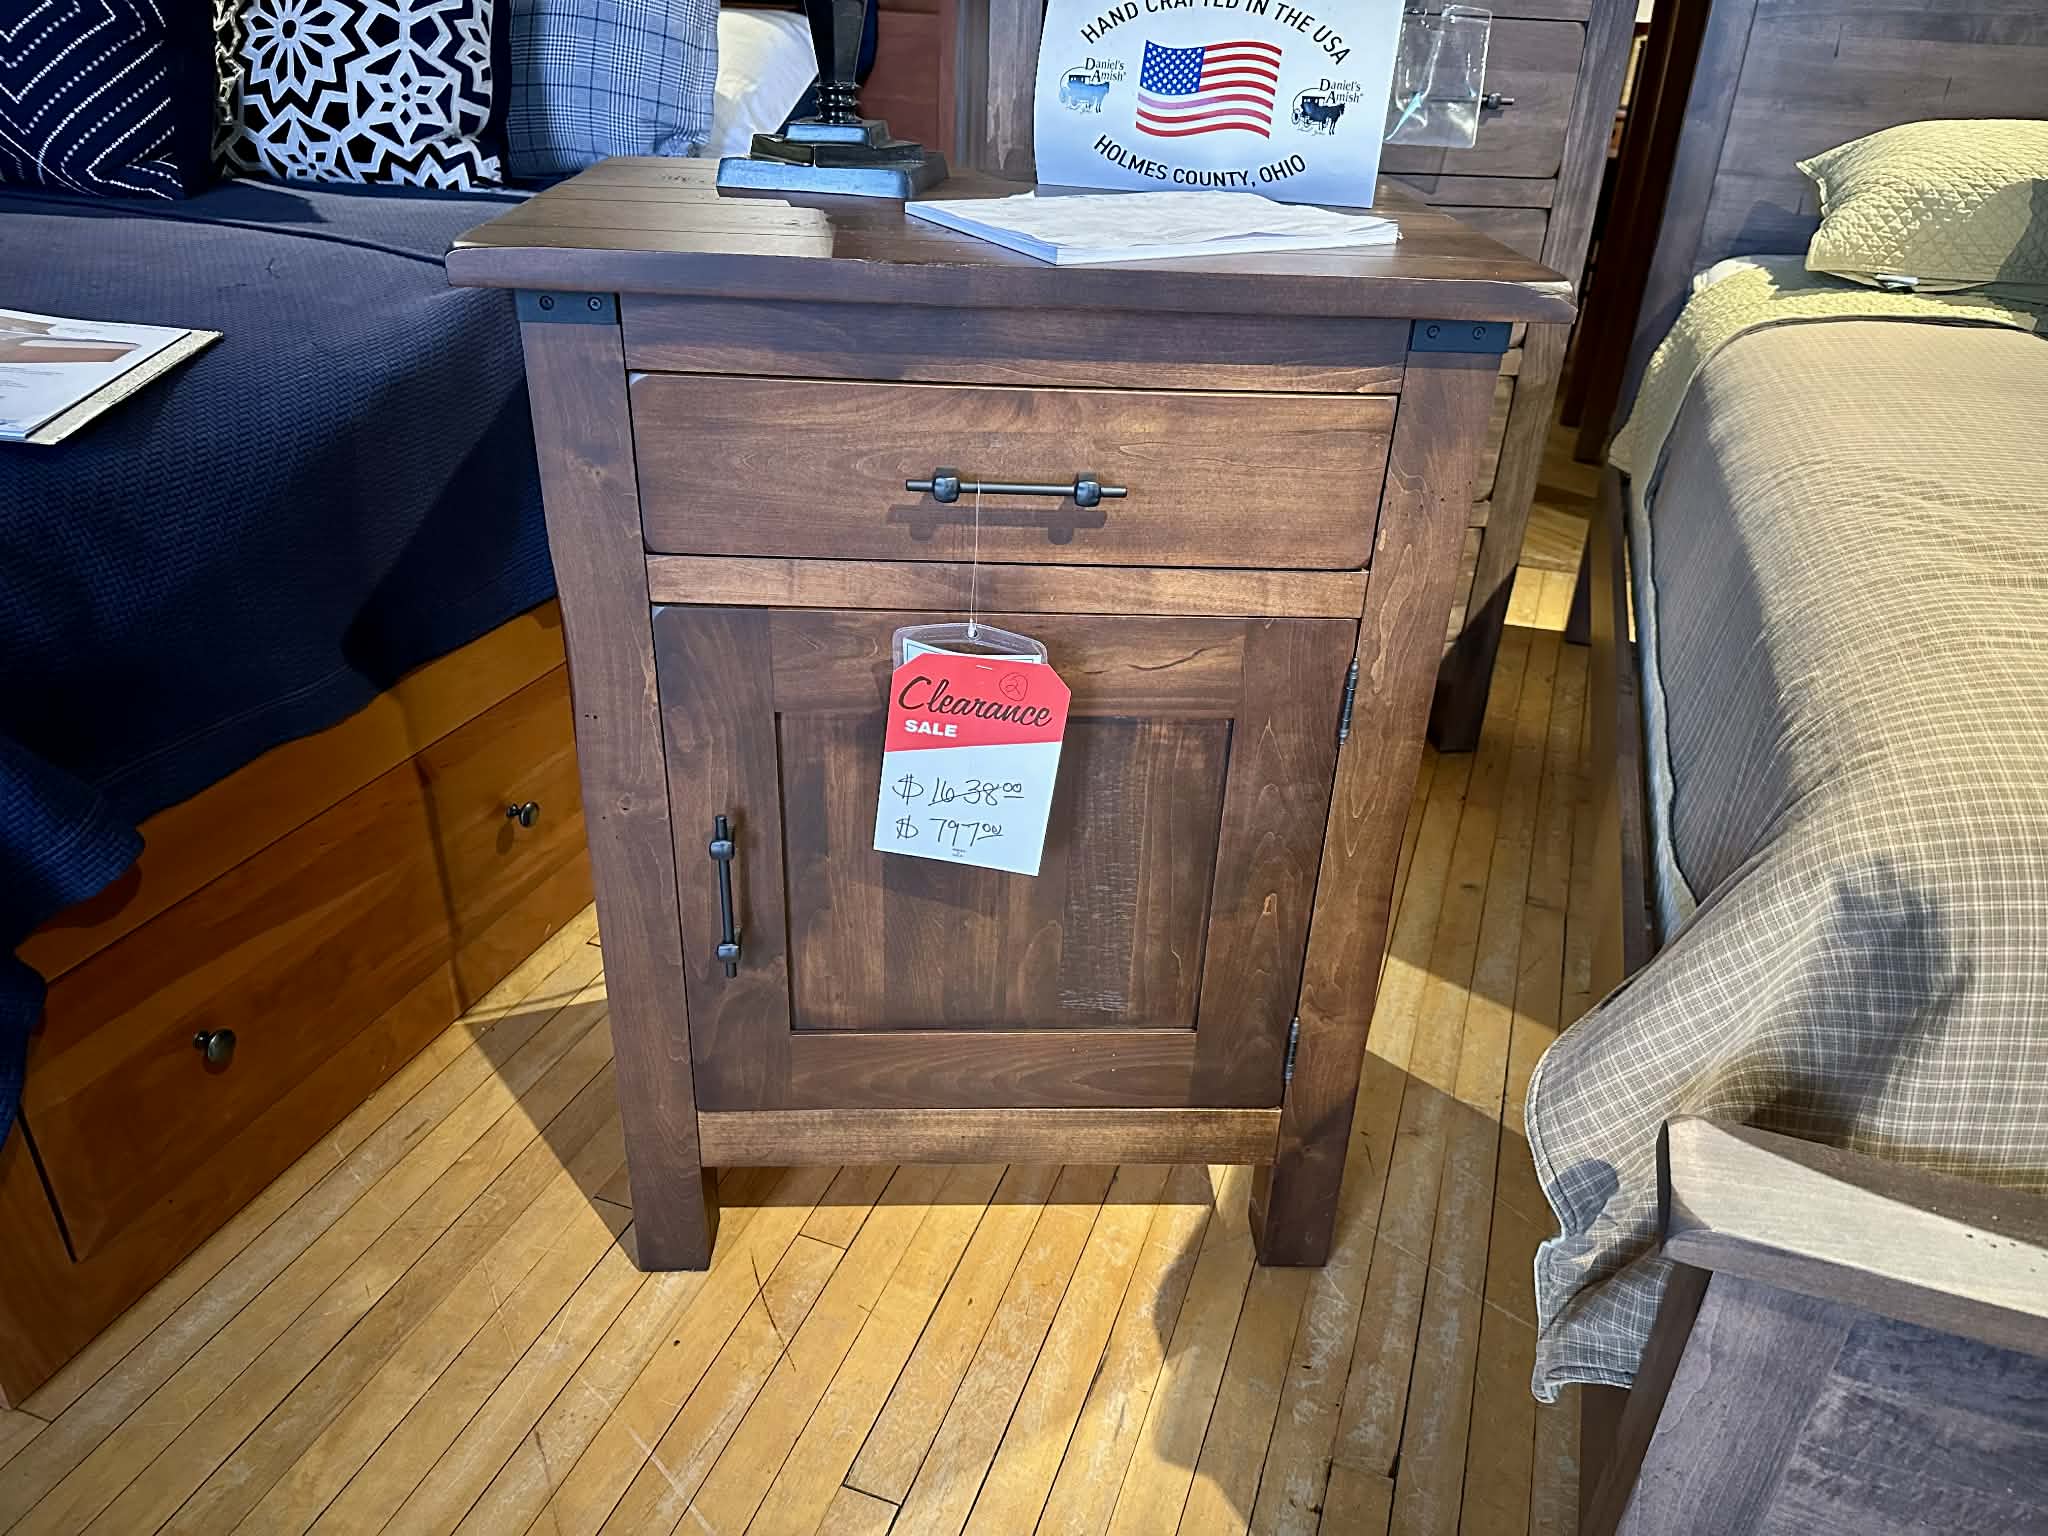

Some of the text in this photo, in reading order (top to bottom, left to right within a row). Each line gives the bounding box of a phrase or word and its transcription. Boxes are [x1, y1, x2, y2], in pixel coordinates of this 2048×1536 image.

[1080, 2, 1139, 44] HAND
[1245, 0, 1270, 15] IN
[1274, 2, 1316, 33] THE
[1312, 24, 1351, 65] USA
[1085, 57, 1125, 70] Daniel's
[1319, 78, 1361, 92] Daniel's
[1093, 134, 1306, 187] HOLMES COUNTY, OHIO
[898, 676, 1052, 727] Clearance
[904, 720, 957, 737] SALE
[892, 773, 924, 806] $
[896, 815, 919, 839] $
